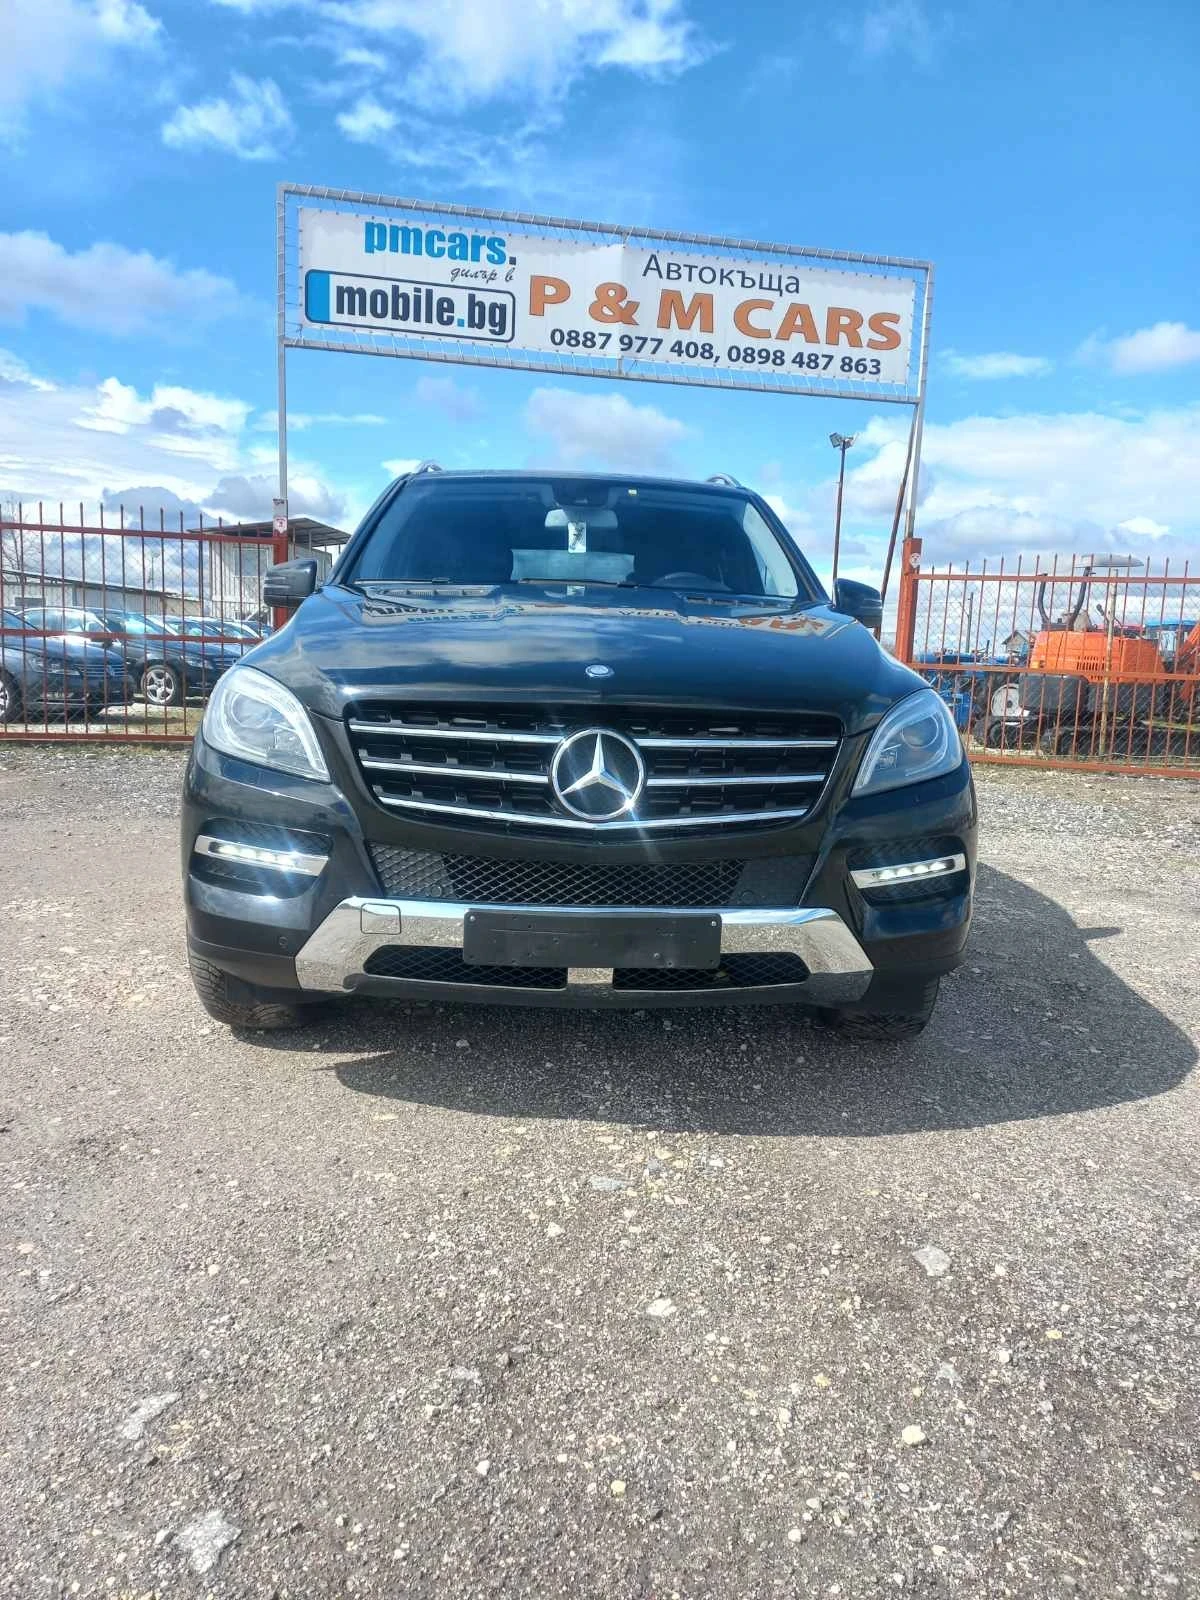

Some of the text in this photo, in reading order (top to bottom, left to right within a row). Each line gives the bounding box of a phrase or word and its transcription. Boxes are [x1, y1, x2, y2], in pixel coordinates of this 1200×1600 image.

[642, 253, 800, 297] Автокъща
[336, 284, 507, 335] mobile.bg
[528, 274, 901, 351] P & M CARS
[550, 328, 881, 375] 0887 977 408, 0898 487 863
